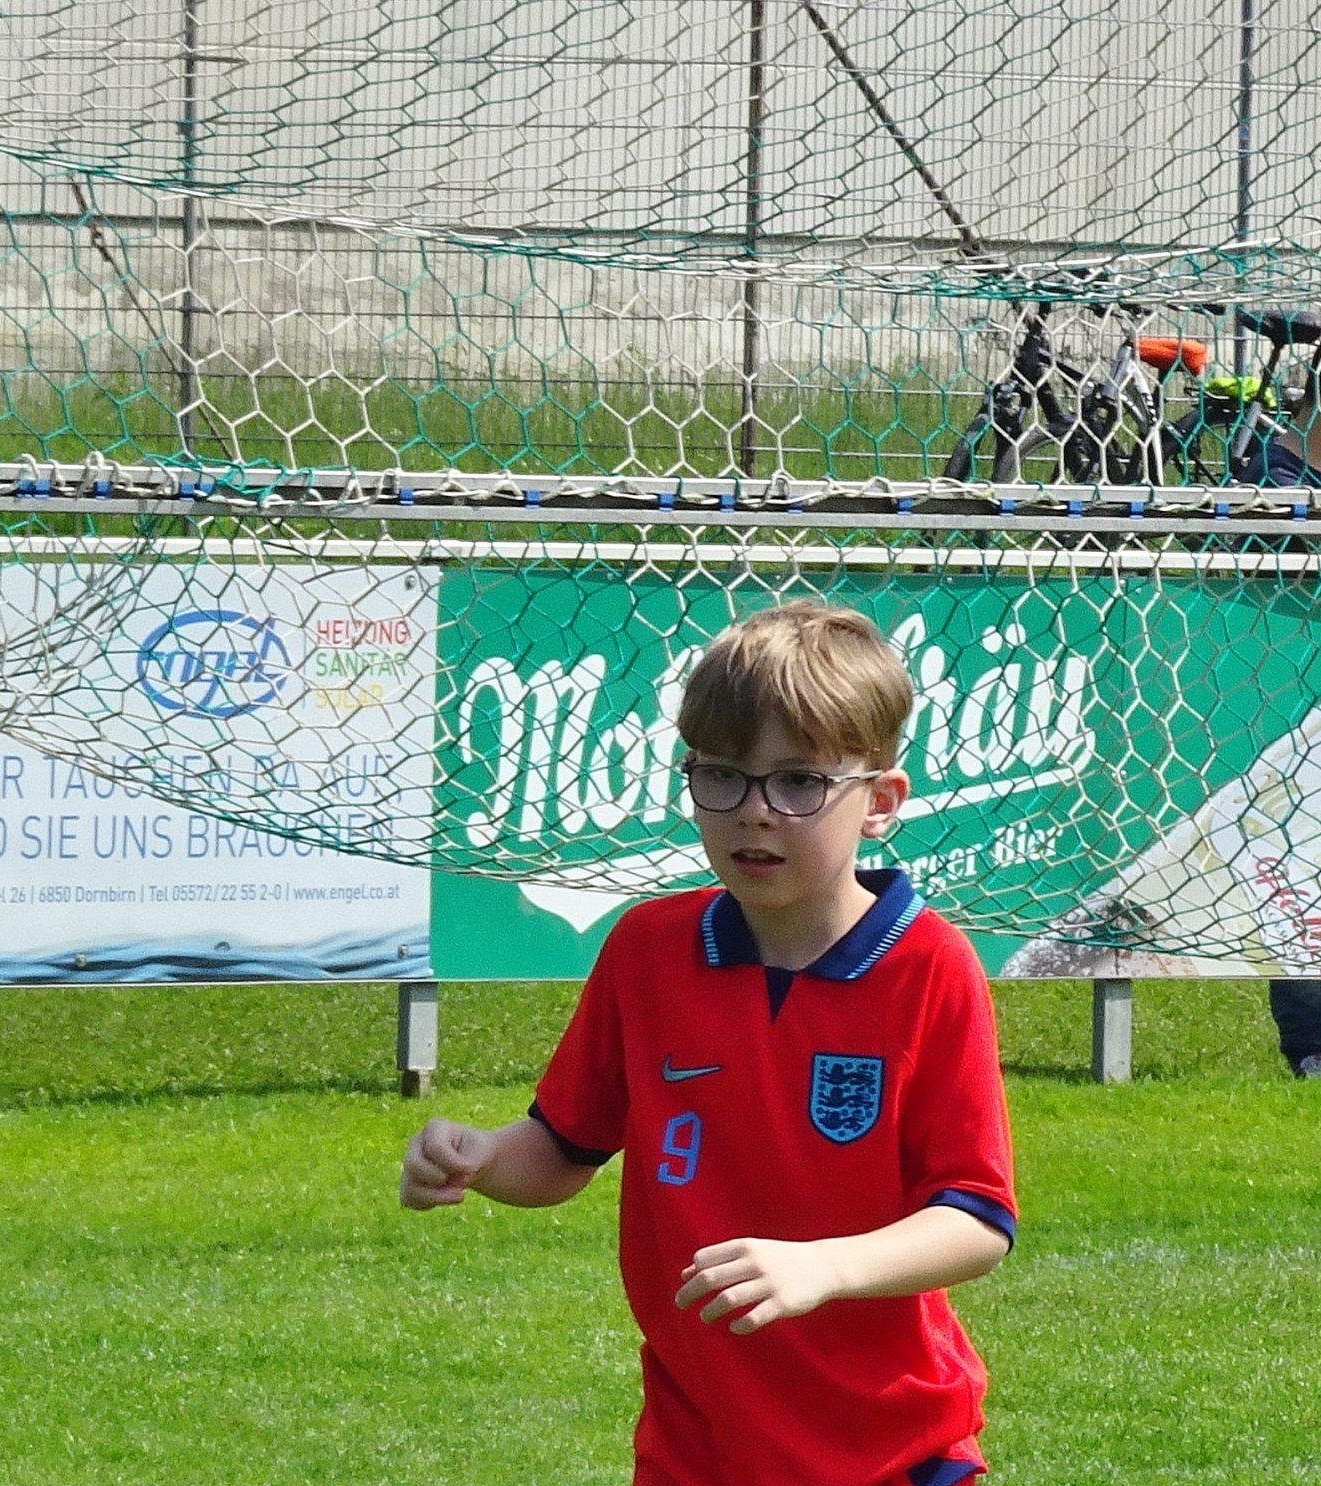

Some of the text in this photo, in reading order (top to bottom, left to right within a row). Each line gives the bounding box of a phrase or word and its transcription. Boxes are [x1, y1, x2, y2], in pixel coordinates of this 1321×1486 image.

[43, 755, 231, 799] TAUCHEN
[21, 815, 80, 859] SIE
[93, 815, 173, 859] UNS
[10, 887, 26, 903] 26
[38, 886, 71, 903] 6850
[75, 885, 136, 903] Dornbirn
[149, 885, 168, 902] Tel
[293, 883, 400, 904] www.engel.co.at
[656, 1111, 702, 1186] 9
